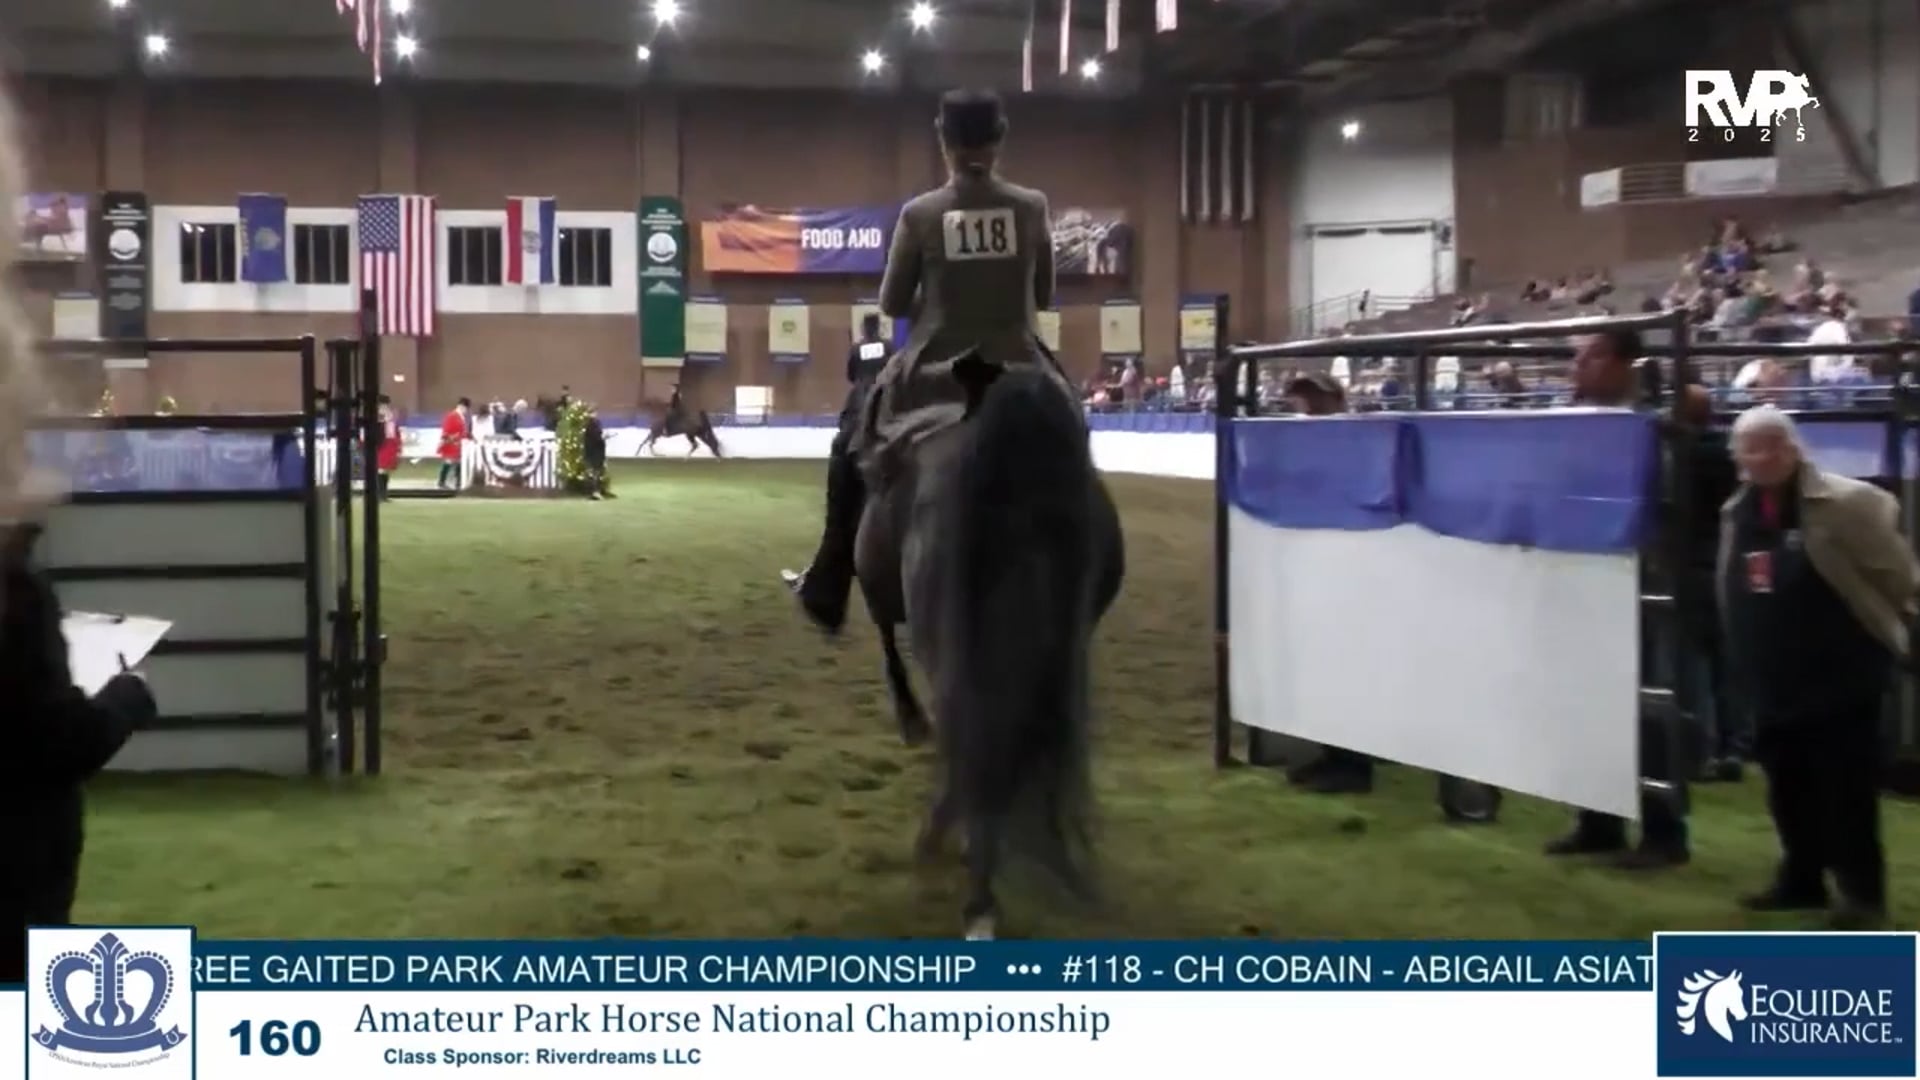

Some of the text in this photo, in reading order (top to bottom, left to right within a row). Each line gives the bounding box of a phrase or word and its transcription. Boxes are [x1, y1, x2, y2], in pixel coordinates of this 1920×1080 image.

[801, 227, 844, 250] FOOD
[847, 226, 882, 249] AND
[956, 217, 1008, 254] 118
